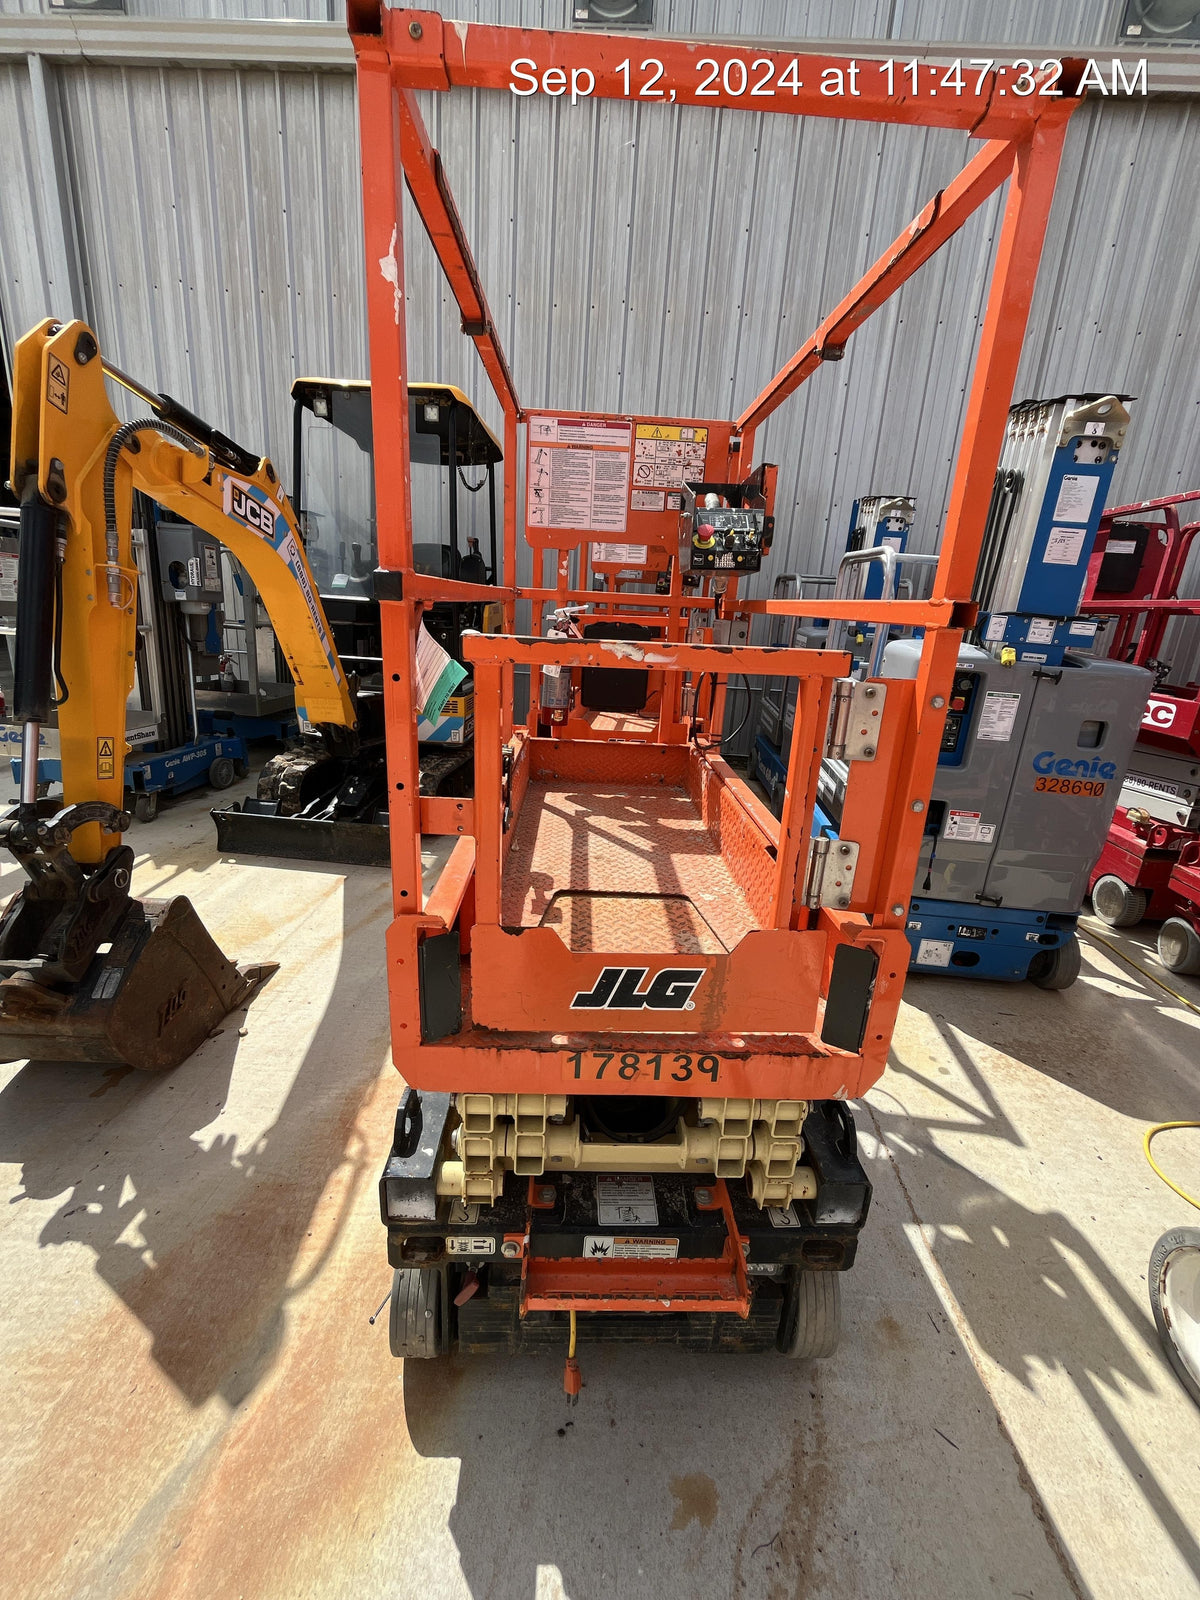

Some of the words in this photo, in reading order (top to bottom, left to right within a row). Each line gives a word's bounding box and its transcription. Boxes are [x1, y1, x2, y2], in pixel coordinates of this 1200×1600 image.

[233, 489, 273, 535] JCB
[1032, 750, 1117, 780] Genie
[1035, 777, 1105, 797] 328690
[569, 967, 707, 1011] JLG
[566, 1052, 720, 1083] 178139
